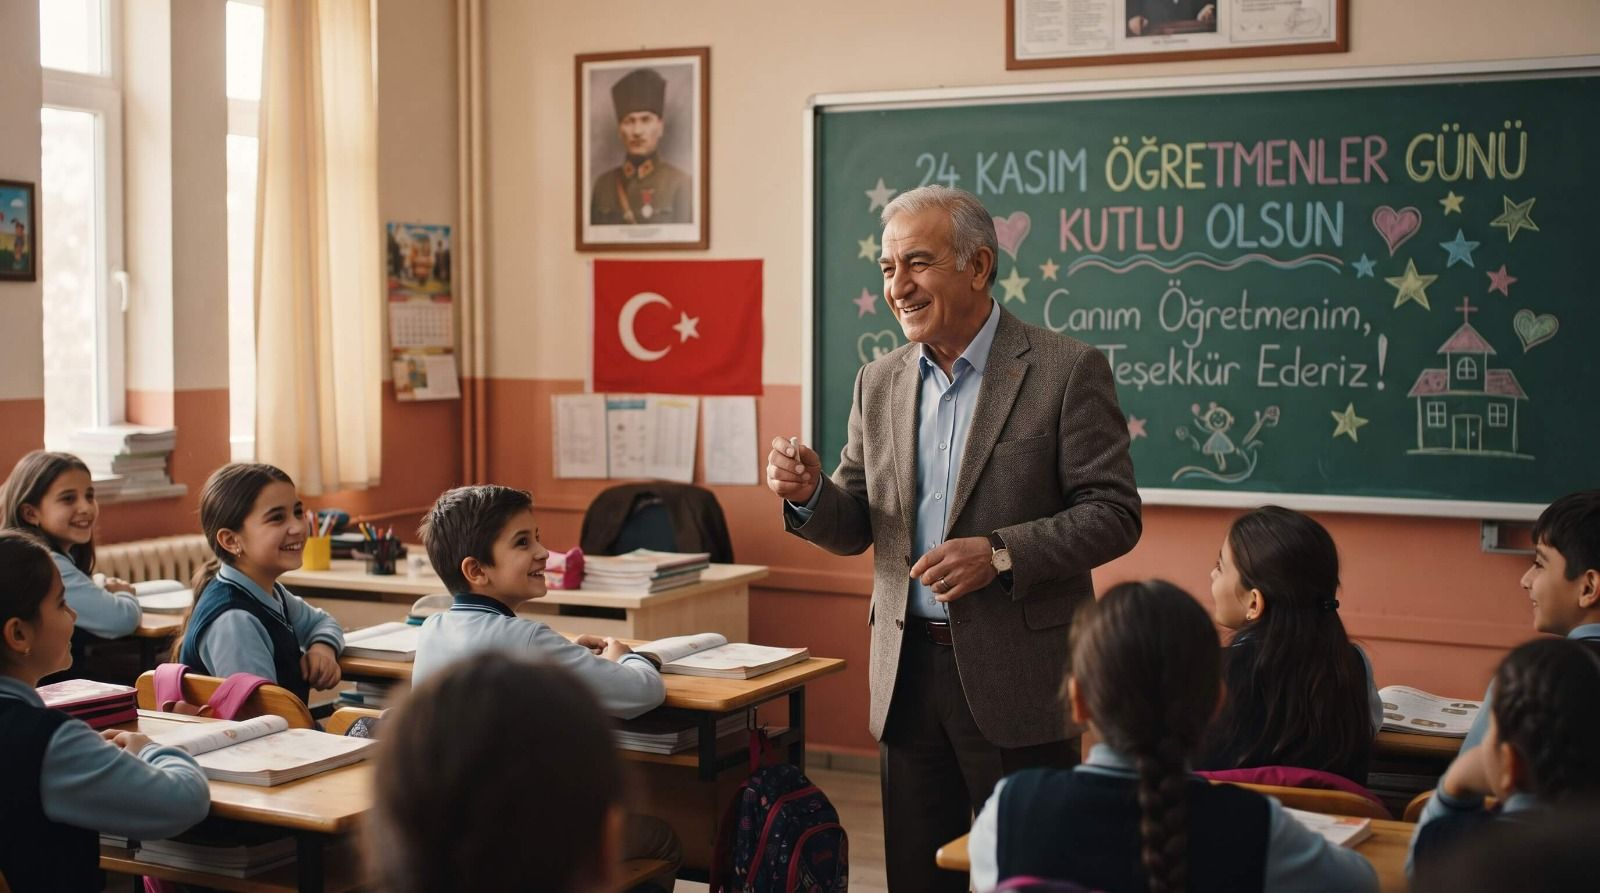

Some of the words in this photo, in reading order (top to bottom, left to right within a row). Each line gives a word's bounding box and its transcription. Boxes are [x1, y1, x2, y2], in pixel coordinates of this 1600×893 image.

[915, 152, 960, 191] 24
[976, 148, 1087, 195] KASIM
[1105, 135, 1389, 192] ÖĞRETMENLER
[1405, 120, 1527, 182] GÜNÜ
[1059, 205, 1184, 252] KUTLU
[1206, 201, 1344, 248] OLSUN
[1044, 288, 1141, 332] Canım
[1159, 279, 1371, 348] Öğretmenim,
